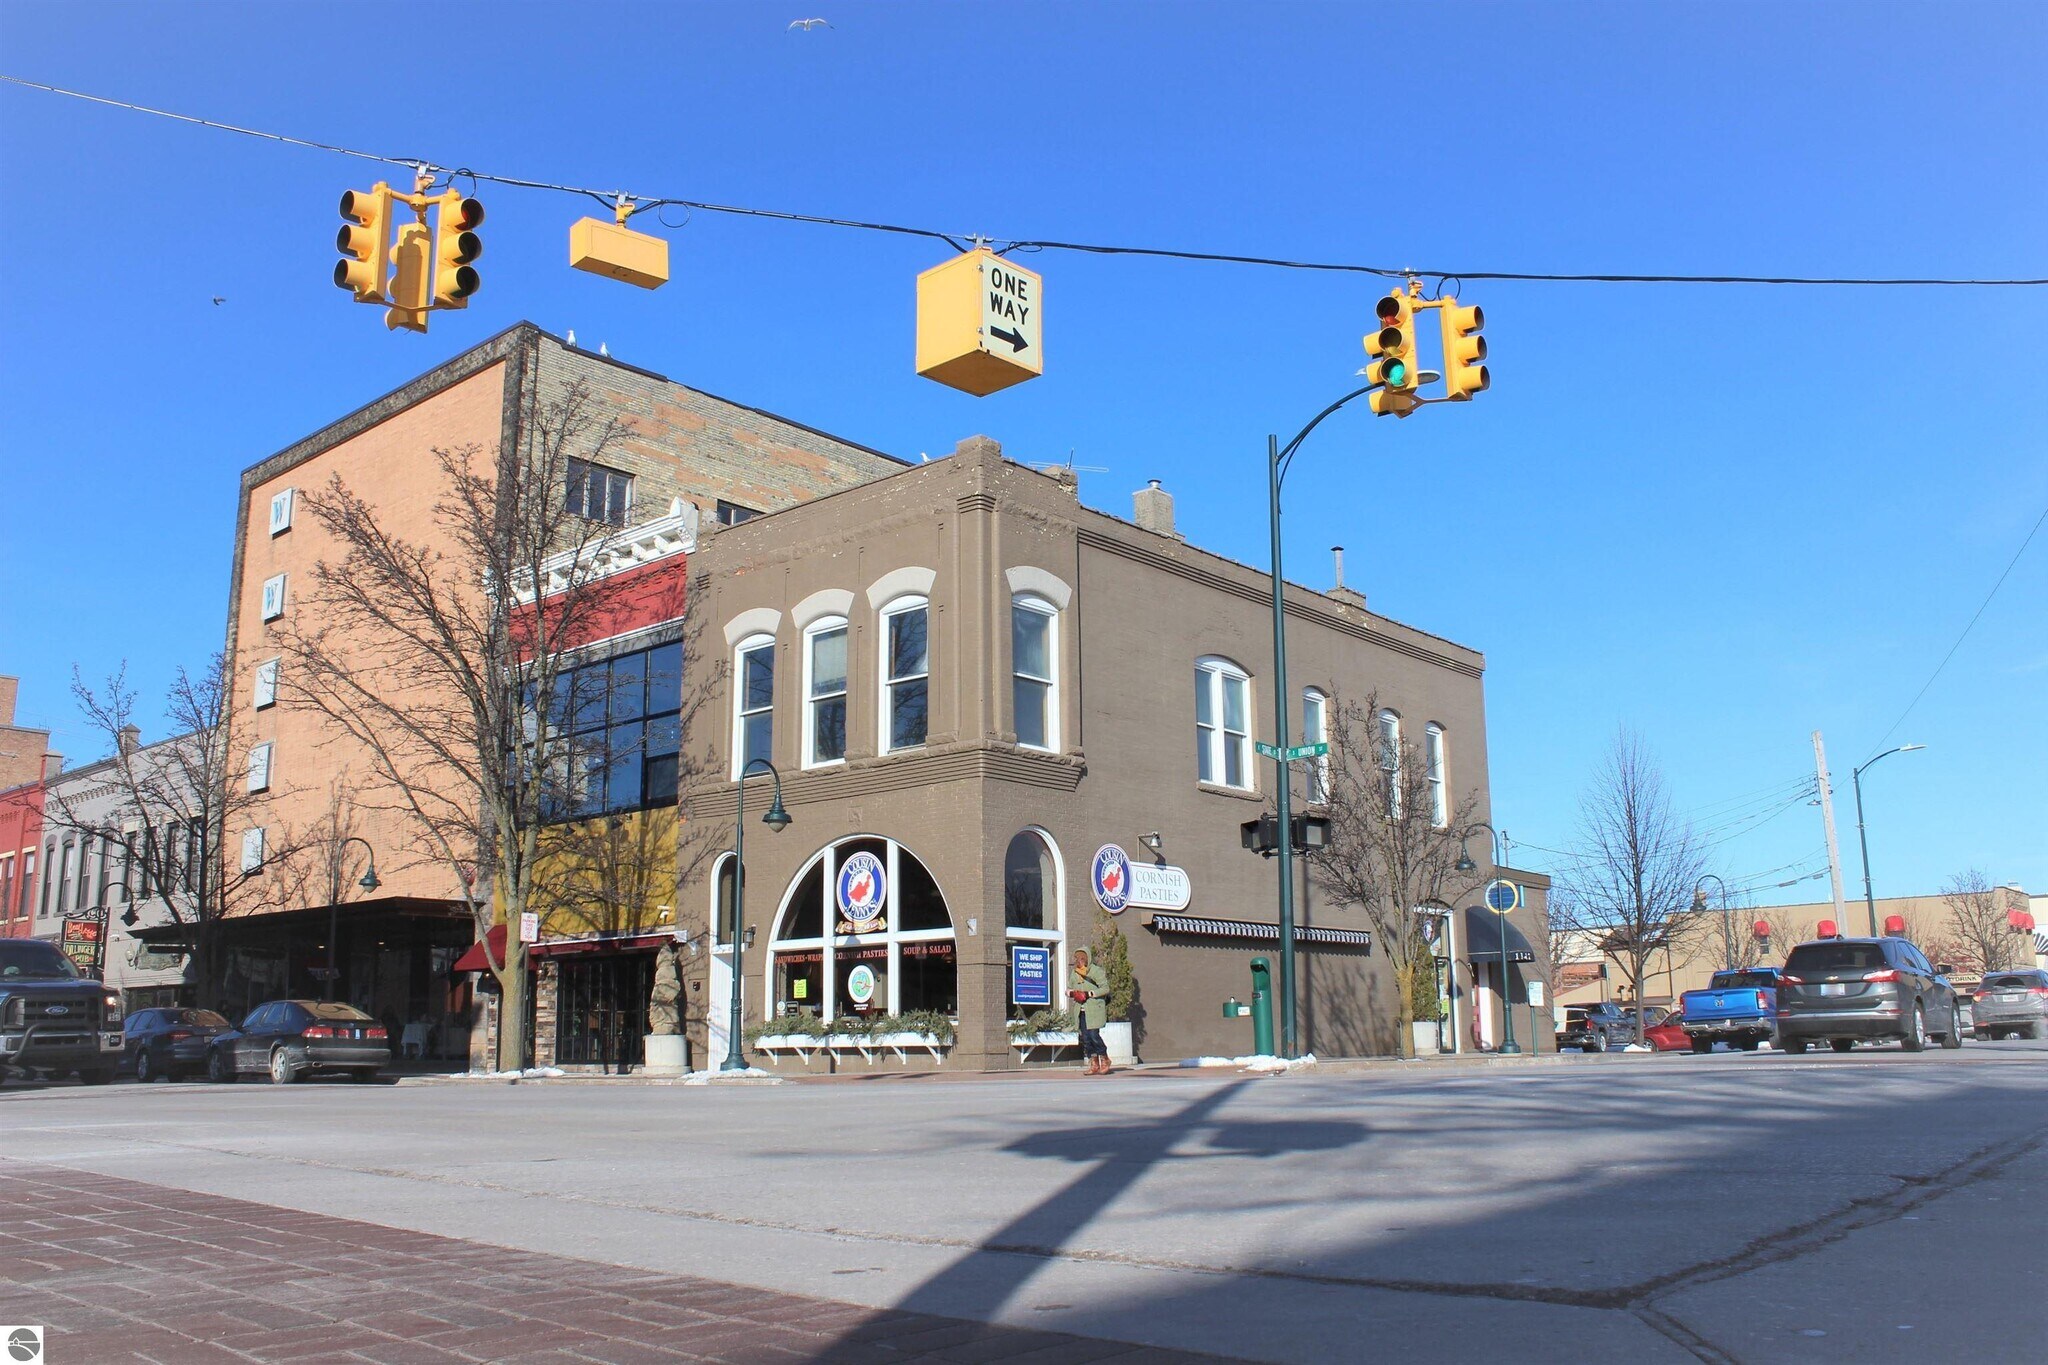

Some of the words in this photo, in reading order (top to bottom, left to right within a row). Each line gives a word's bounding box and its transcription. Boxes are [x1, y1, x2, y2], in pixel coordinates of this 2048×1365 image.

[992, 268, 1027, 301] ONE
[990, 291, 1029, 325] WAY
[1298, 746, 1315, 756] UNION
[1100, 849, 1125, 866] COUSIN
[847, 857, 877, 875] COUSIN
[1135, 870, 1182, 887] CORNISH
[1139, 886, 1179, 902] PASTIES
[862, 949, 888, 959] PASTIES
[903, 946, 921, 955] SOUP
[922, 946, 927, 954] &
[929, 945, 951, 954] SALAD
[75, 955, 90, 963] PUB
[1018, 961, 1044, 970] CORNISH
[1019, 970, 1043, 978] PASTIES
